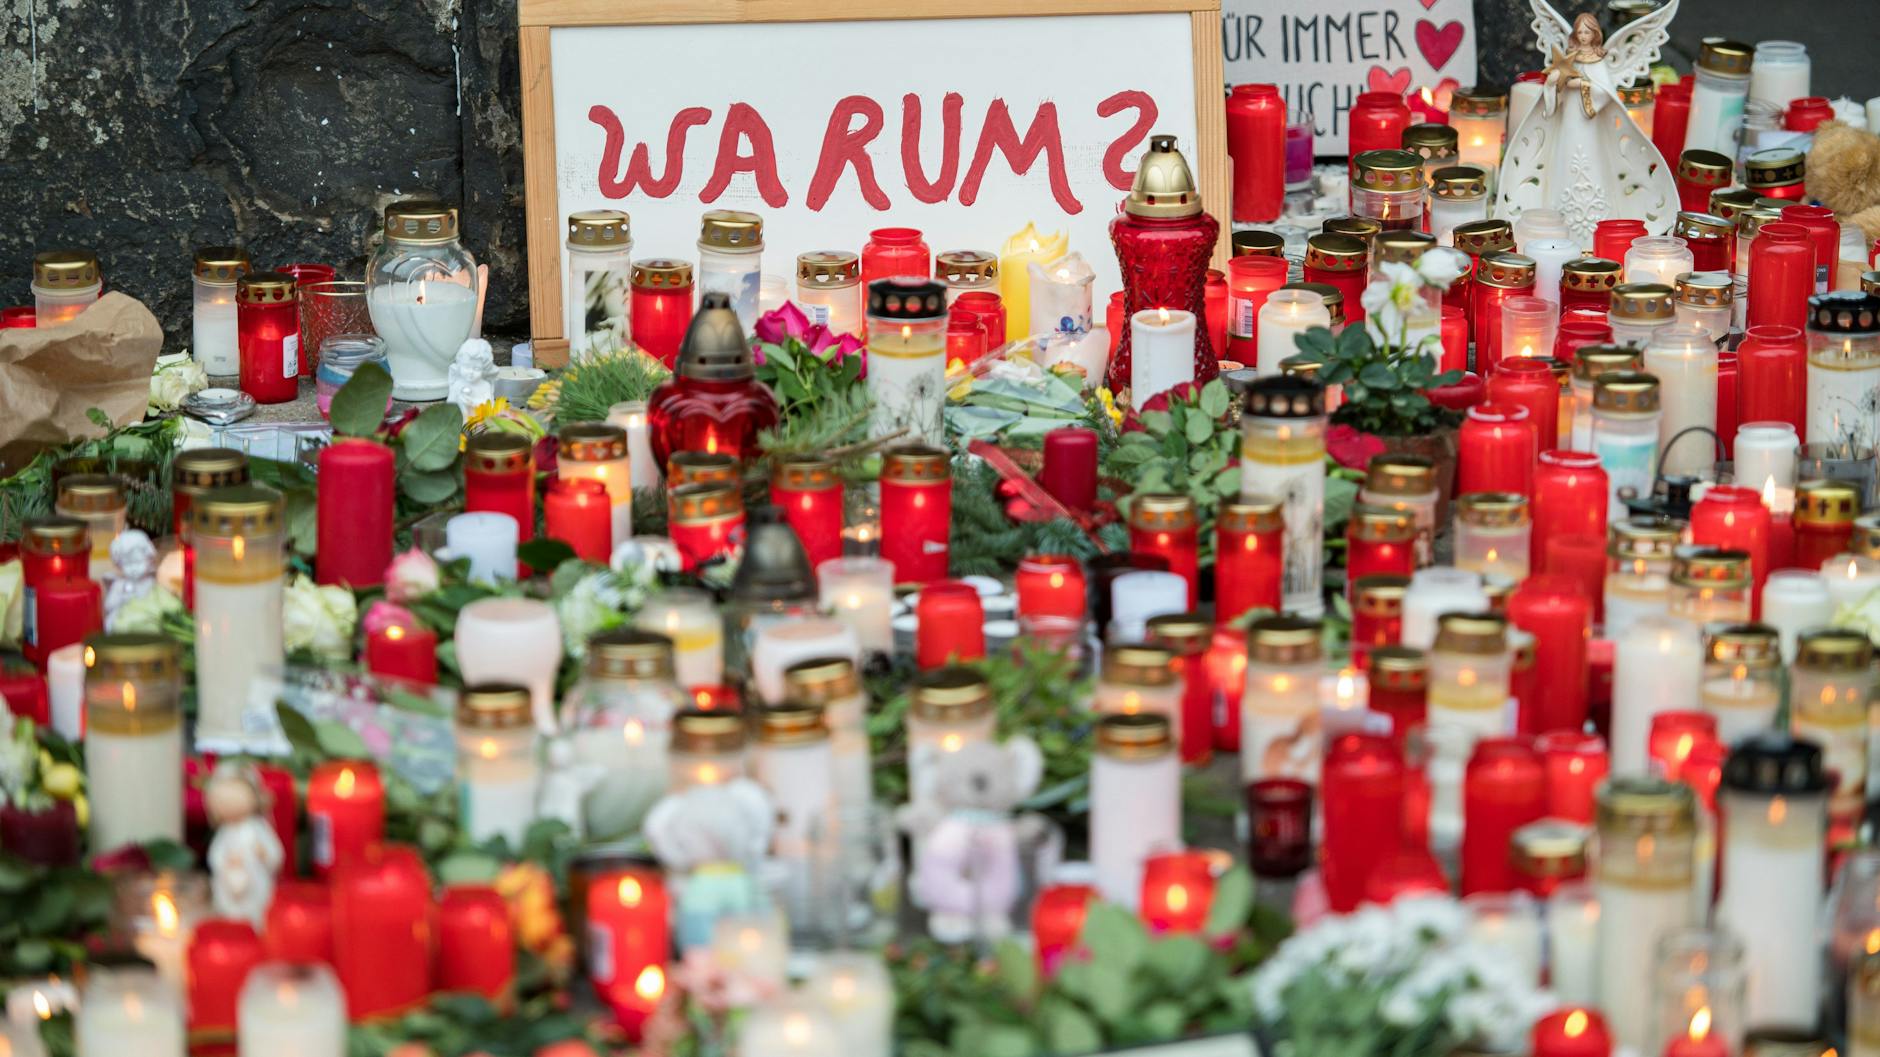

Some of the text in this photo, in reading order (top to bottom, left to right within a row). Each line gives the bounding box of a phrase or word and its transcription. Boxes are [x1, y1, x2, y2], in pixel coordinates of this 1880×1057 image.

[1222, 10, 1406, 63] ÜR IMMER
[1266, 82, 1364, 136] UCH
